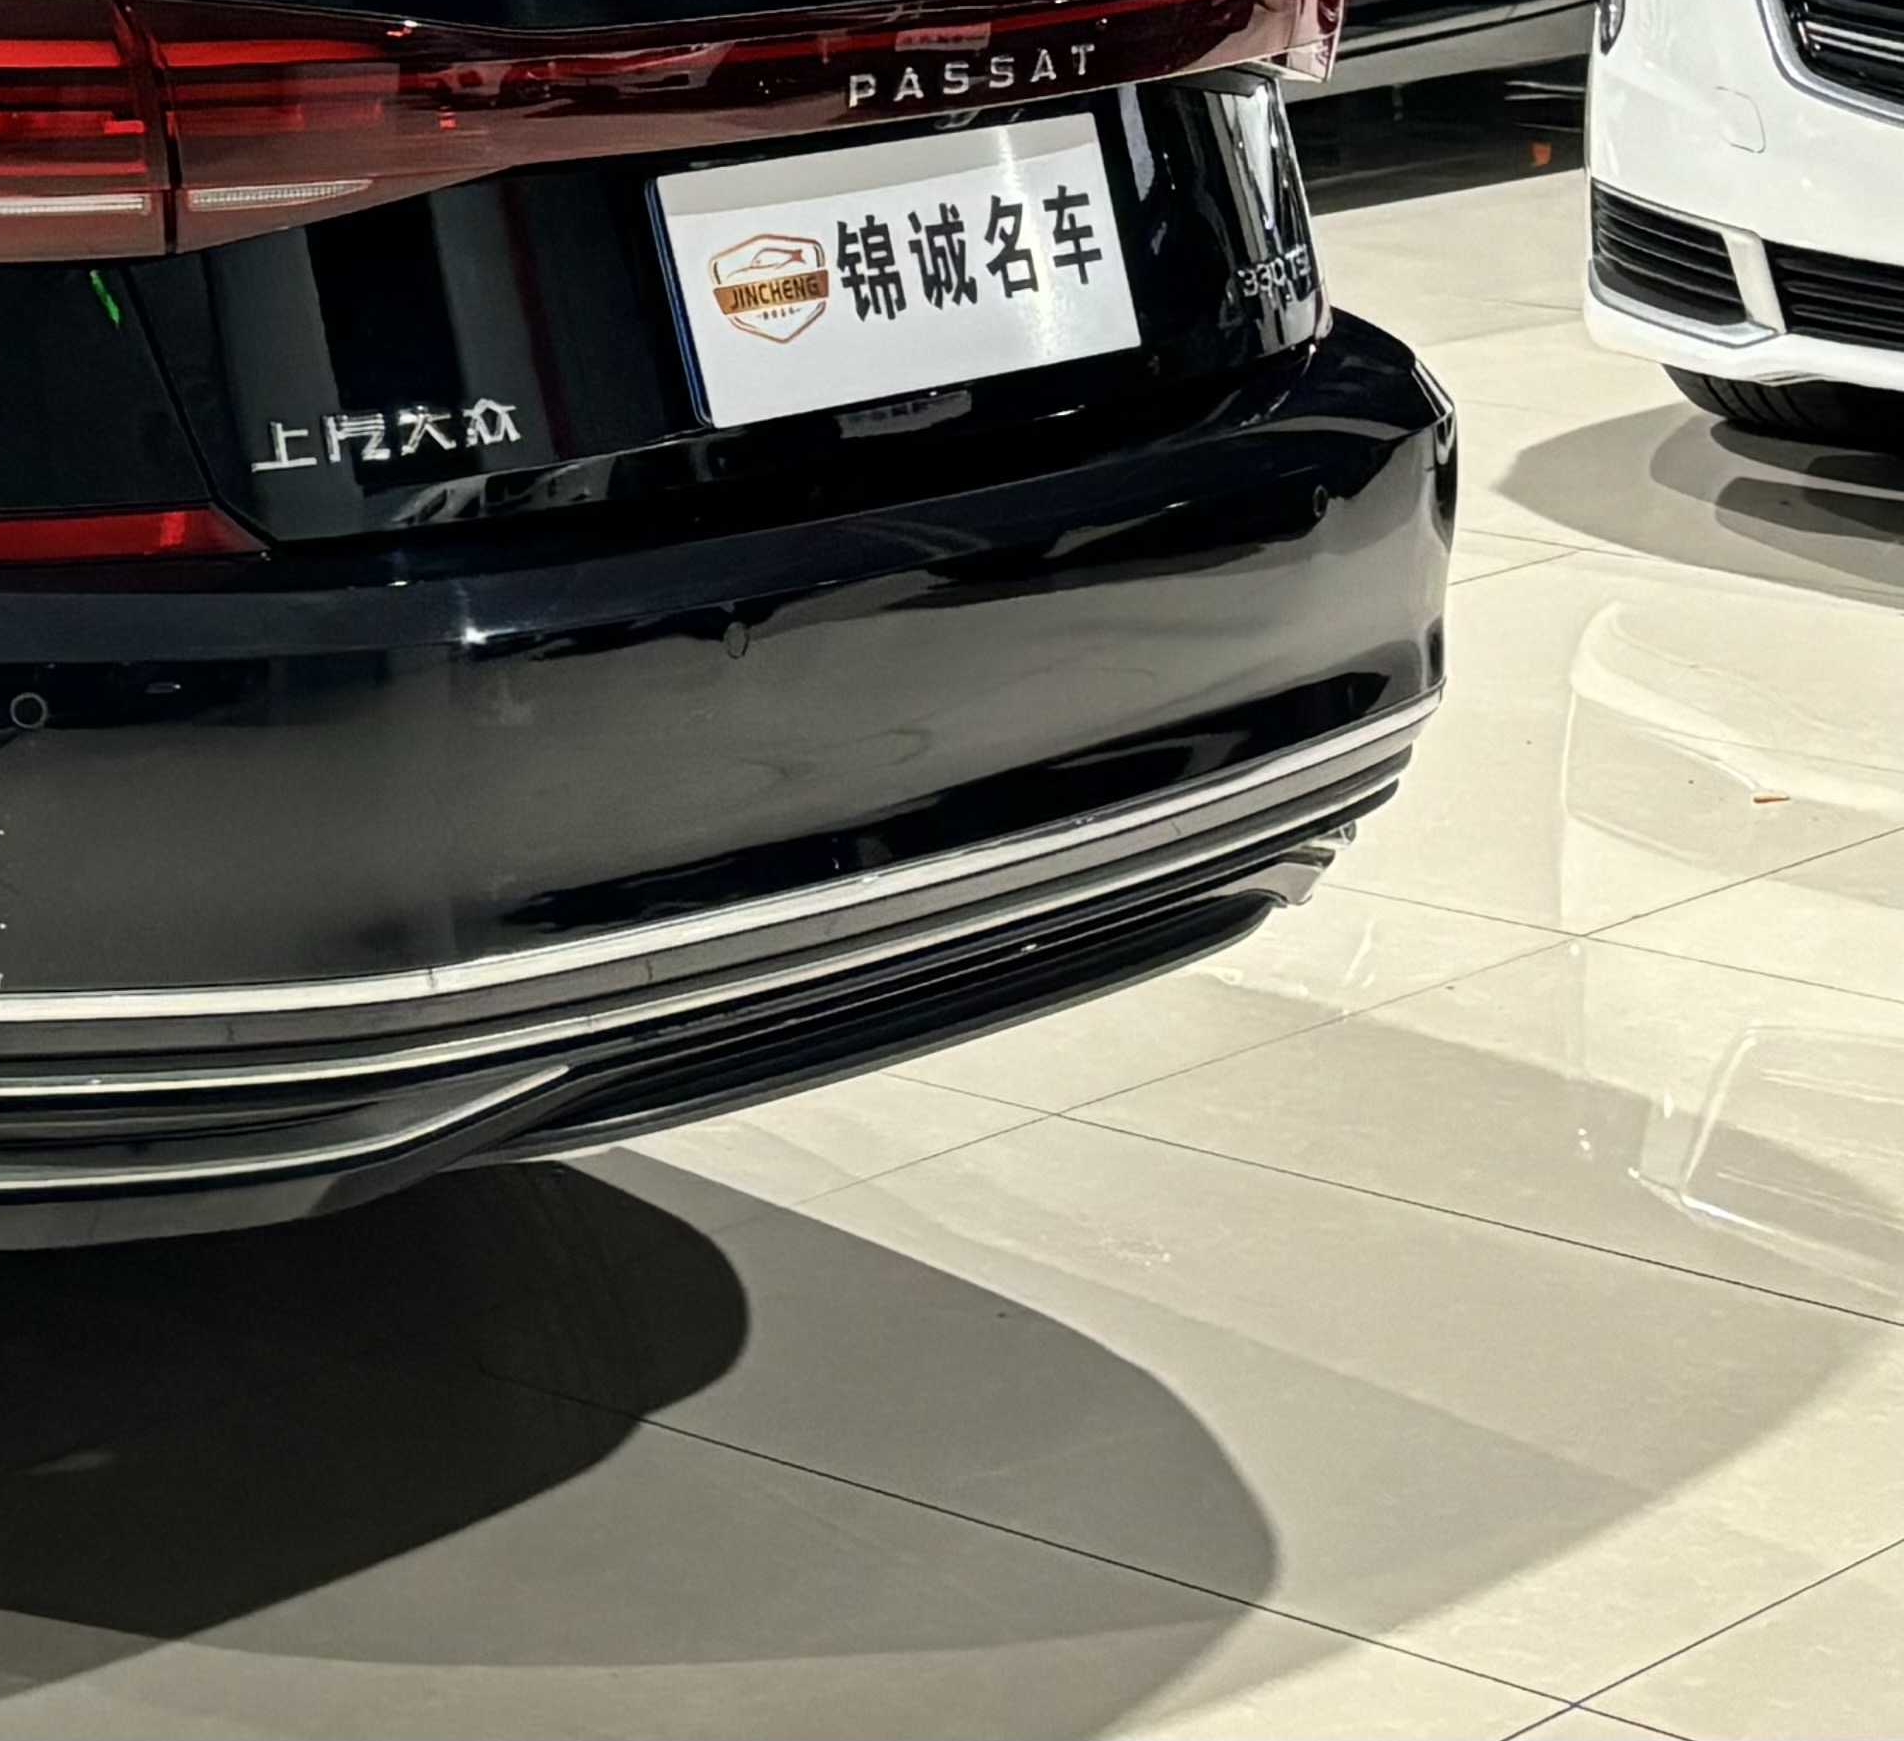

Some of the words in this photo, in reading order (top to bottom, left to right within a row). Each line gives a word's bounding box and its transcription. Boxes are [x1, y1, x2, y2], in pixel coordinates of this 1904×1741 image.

[848, 43, 1095, 109] PASSAT
[836, 184, 1103, 322] 锦诚名车
[730, 273, 820, 311] JINCHENG
